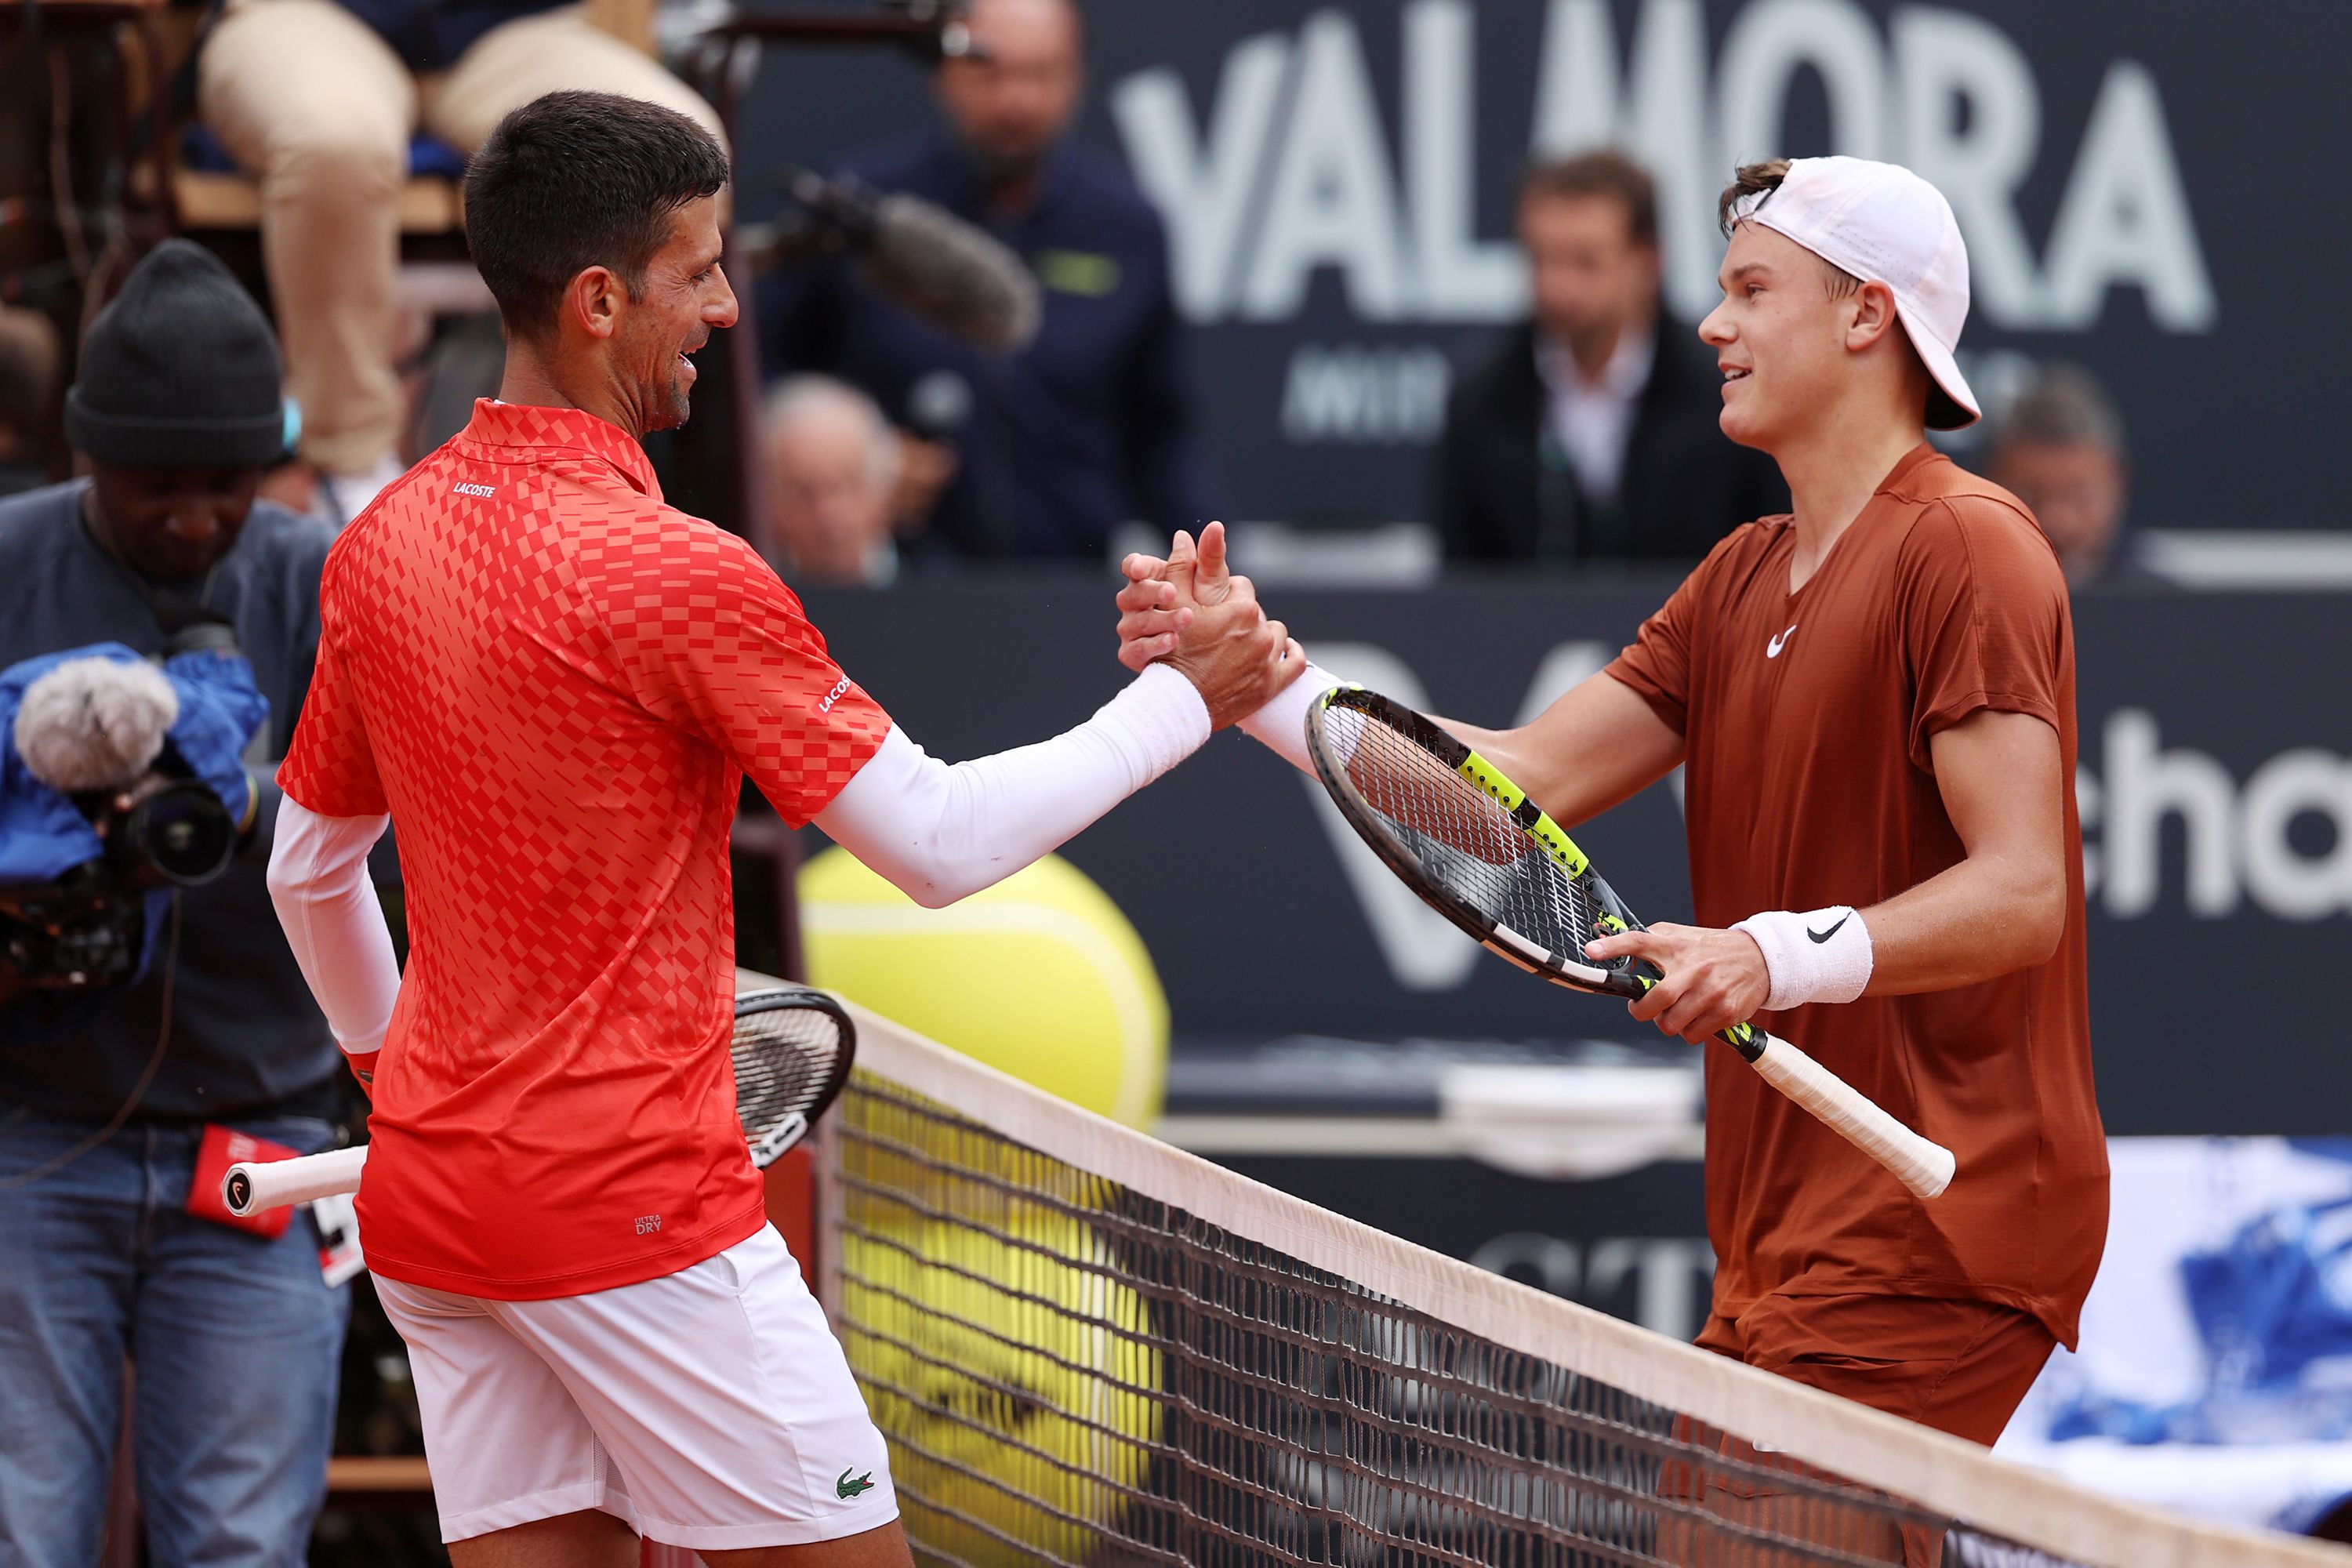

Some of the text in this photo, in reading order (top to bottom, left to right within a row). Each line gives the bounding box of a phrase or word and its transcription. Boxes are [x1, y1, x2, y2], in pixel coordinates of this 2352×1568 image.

[1110, 0, 2217, 330] VALMORA
[452, 481, 495, 499] LACOSTE
[634, 1214, 661, 1225] ULTRA
[636, 1221, 662, 1235] DRY
